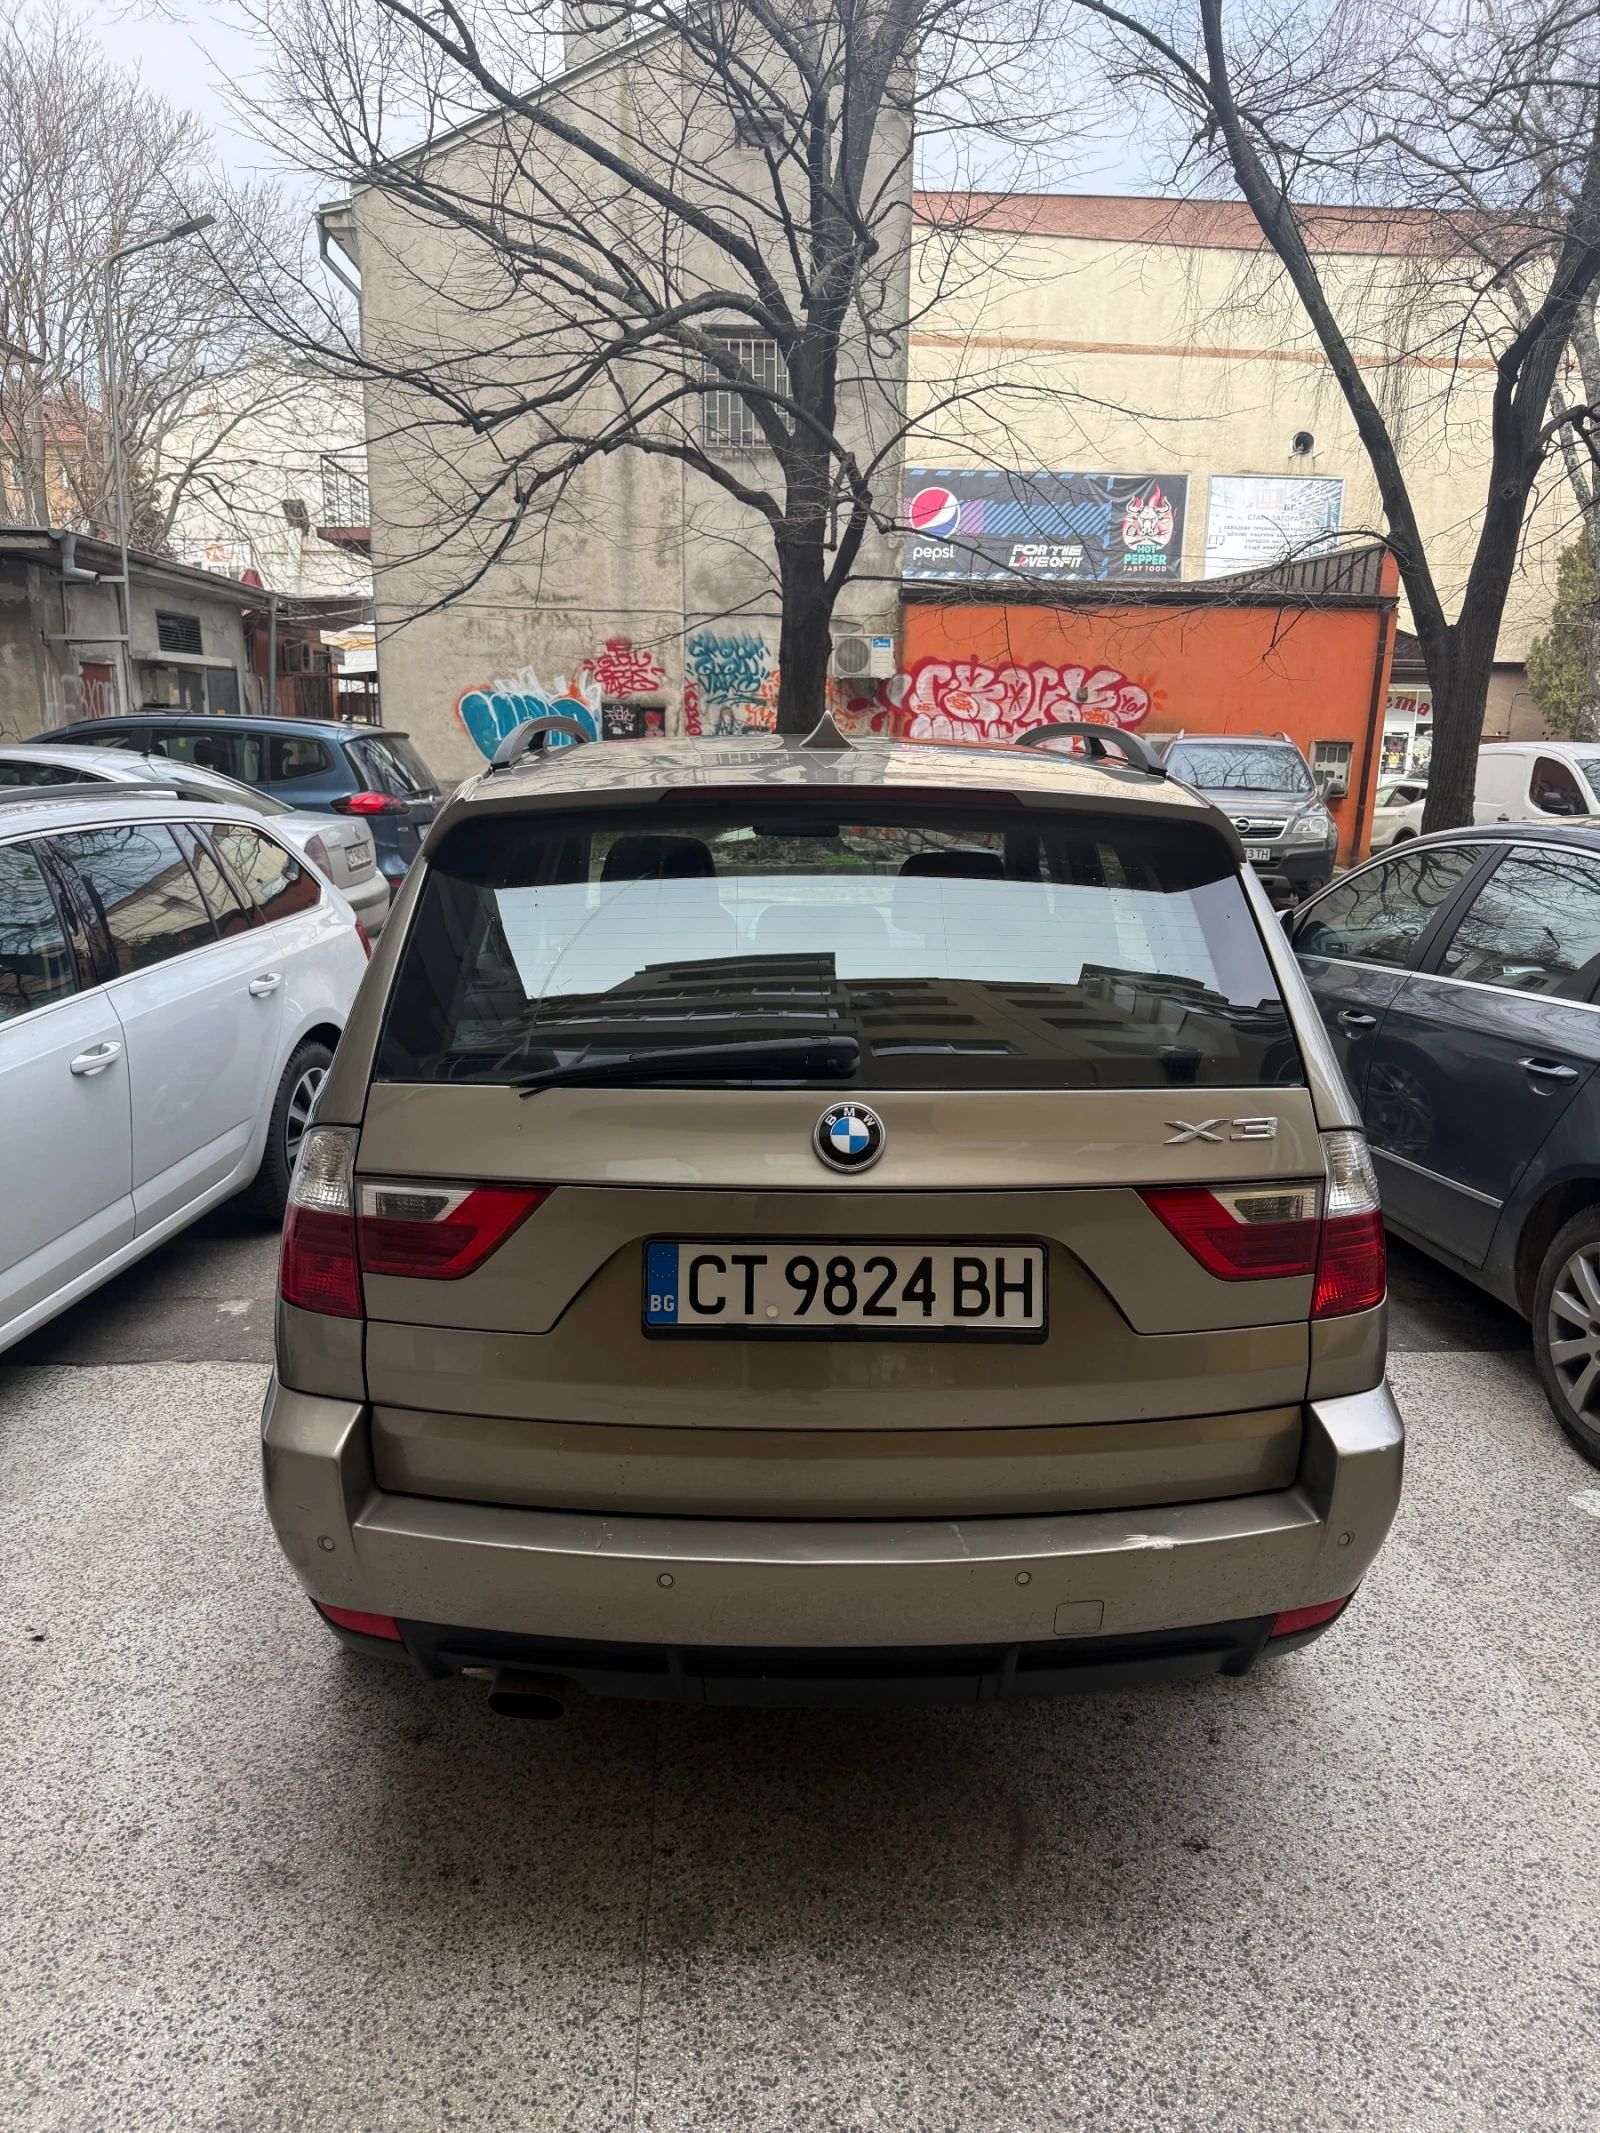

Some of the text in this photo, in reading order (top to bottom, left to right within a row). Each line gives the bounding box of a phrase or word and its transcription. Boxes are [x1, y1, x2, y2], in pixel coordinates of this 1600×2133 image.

[912, 545, 954, 561] pepsi
[1012, 544, 1083, 556] FOR THE
[1137, 545, 1157, 554] HOT
[1123, 553, 1167, 565] PEPPER
[825, 1107, 876, 1128] BMW
[1163, 1116, 1278, 1144] X3
[688, 1254, 1033, 1318] CT 9824 BH
[650, 1294, 675, 1312] BG
